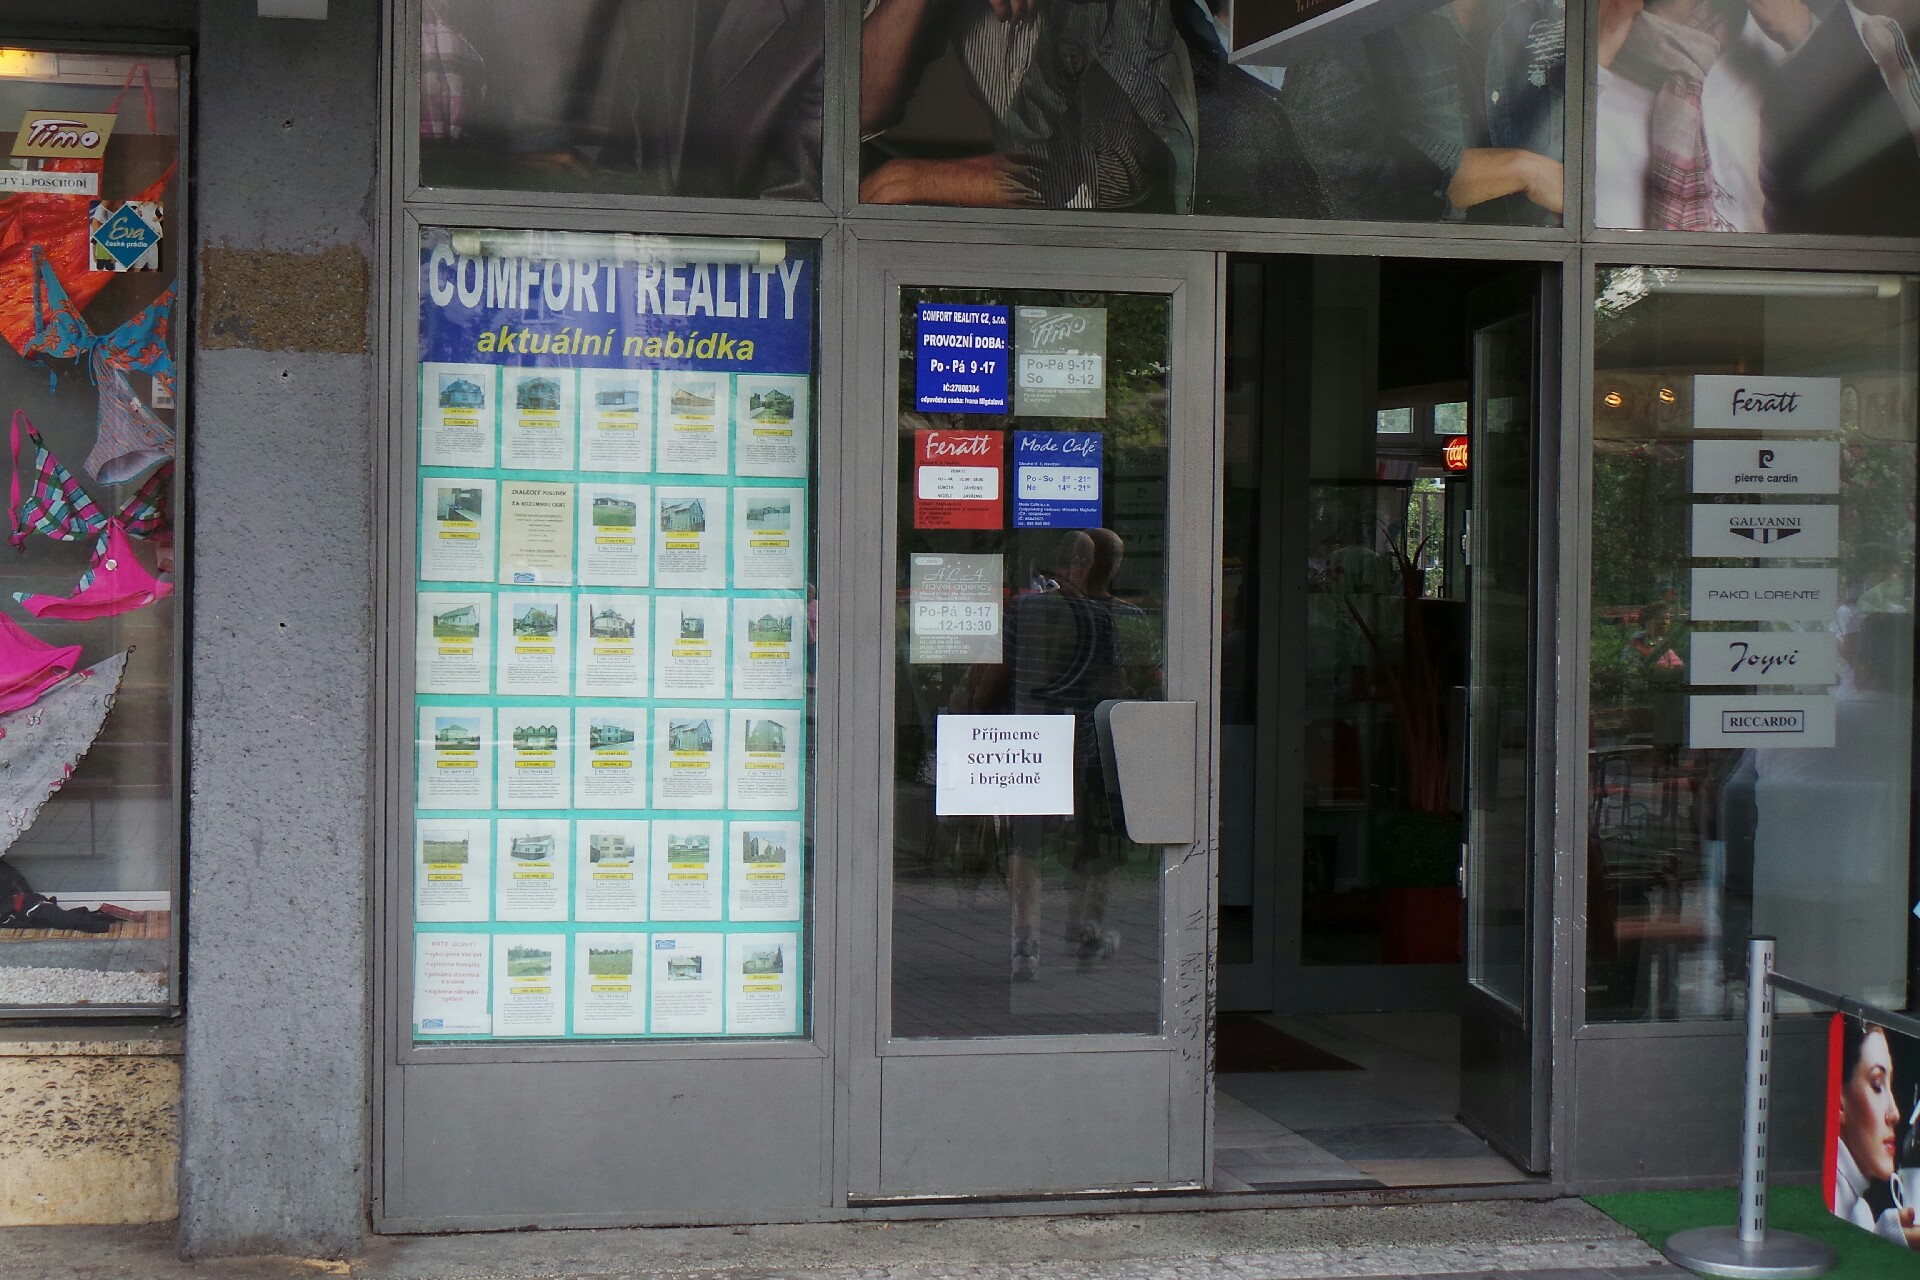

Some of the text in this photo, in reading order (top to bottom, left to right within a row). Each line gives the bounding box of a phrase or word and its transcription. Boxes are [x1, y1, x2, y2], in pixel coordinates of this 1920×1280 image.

[27, 119, 101, 149] Timo
[31, 177, 88, 189] POSCHODÍ
[108, 216, 146, 240] Eva
[429, 243, 804, 320] COMFORT REALITY
[922, 310, 952, 323] COMFORT
[953, 312, 980, 324] REALITY
[980, 313, 991, 325] CZ,
[477, 326, 755, 361] aktuální nabídka
[923, 333, 1005, 349] PROVOZNÍ DOBA:
[930, 359, 944, 372] Po
[952, 360, 966, 373] Pá
[970, 360, 978, 374] 9
[1027, 358, 1094, 372] Po-Pá 9-17
[1026, 372, 1095, 385] So 9-12
[1732, 388, 1803, 416] Feratt
[926, 432, 993, 458] Feratt
[1020, 436, 1098, 458] Mode Café
[1734, 473, 1798, 483] pierre cardin
[1729, 516, 1801, 526] GALVANNI
[1708, 590, 1820, 600] PAKO LORENTE
[919, 605, 991, 617] Po-Pá 9-17
[939, 620, 992, 631] 12-13:30
[1730, 716, 1797, 727] RICCARDO
[971, 727, 1041, 743] Příjmeme
[967, 748, 1043, 764] servírku
[970, 772, 1041, 788] i brigádně
